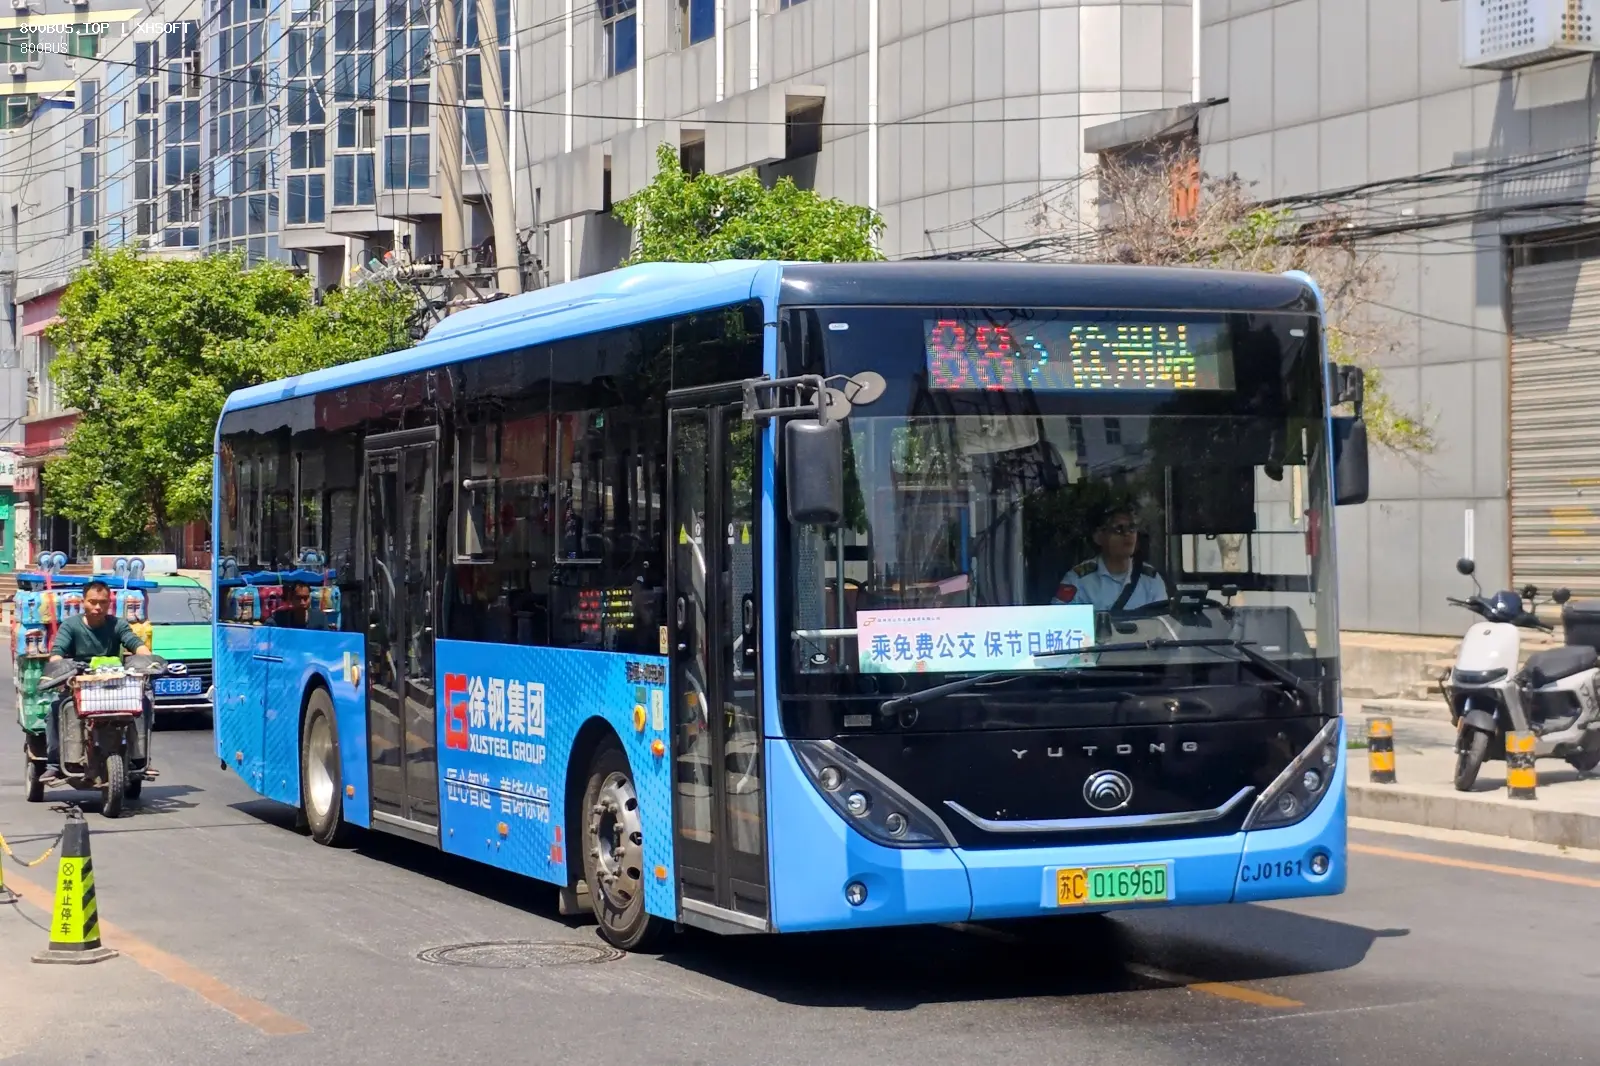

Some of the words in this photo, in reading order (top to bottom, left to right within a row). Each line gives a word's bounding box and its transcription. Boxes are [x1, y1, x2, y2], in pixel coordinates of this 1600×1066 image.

[871, 631, 977, 663] 乘免费公交
[983, 629, 1084, 658] 保节日畅行
[468, 675, 546, 739] 徐钢集团
[469, 733, 511, 759] XUSTEEL
[511, 741, 546, 765] GROUP
[1011, 741, 1199, 760] YUTONG
[1059, 874, 1084, 900] 苏C
[1094, 869, 1166, 898] 01696D
[1241, 859, 1302, 882] CJ0161
[60, 879, 73, 936] 禁止停车
